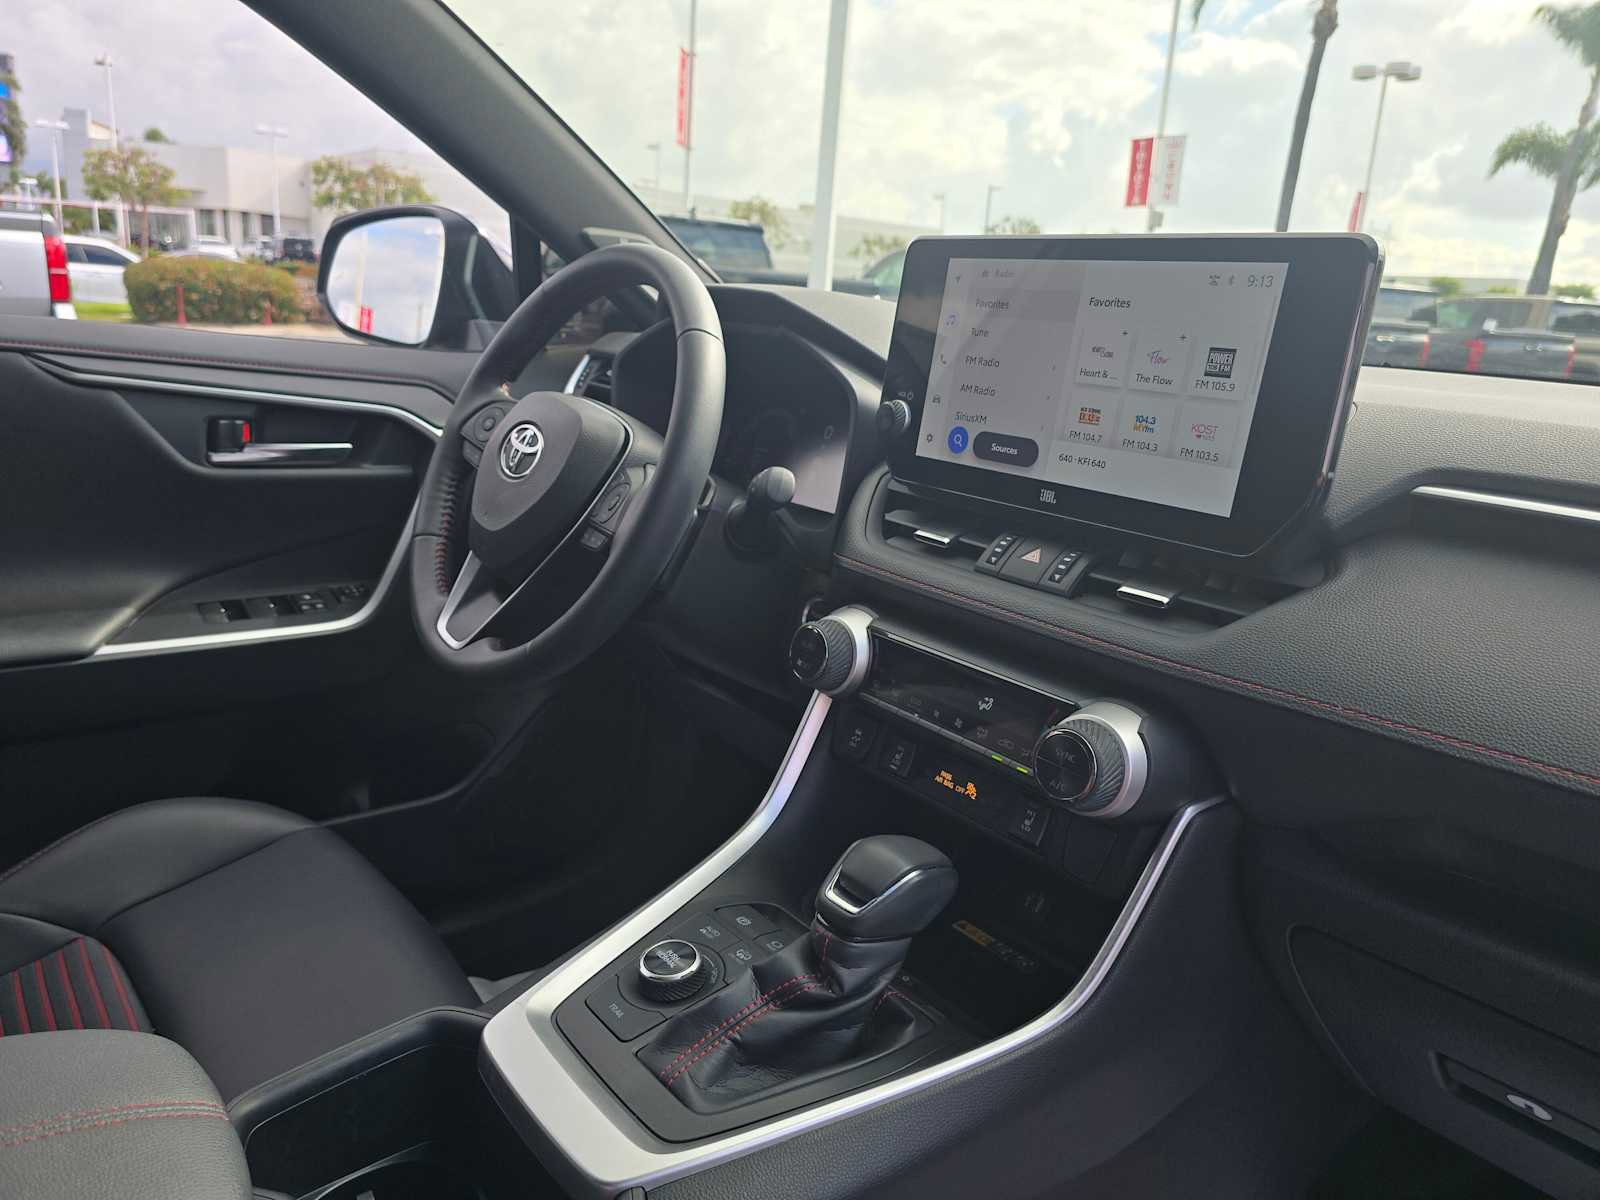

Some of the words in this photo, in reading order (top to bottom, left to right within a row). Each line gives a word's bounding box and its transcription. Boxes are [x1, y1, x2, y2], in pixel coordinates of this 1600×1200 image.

[1247, 274, 1274, 288] 9:13
[974, 298, 1010, 310] Favorites
[1088, 296, 1132, 309] Favorites
[970, 327, 990, 338] Tune
[964, 355, 977, 366] FM
[978, 356, 1000, 368] Radio
[1208, 351, 1234, 365] POWER
[1079, 367, 1101, 378] Heart
[1135, 373, 1151, 383] The
[1152, 375, 1174, 385] Flow
[960, 383, 973, 394] AM
[974, 385, 997, 397] Radio
[1195, 379, 1209, 390] FM
[1210, 381, 1236, 392] 105.9
[954, 411, 988, 424] SiriusXM
[1135, 415, 1157, 425] 104.3
[1190, 423, 1219, 435] KOST
[1069, 430, 1081, 441] FM
[1082, 431, 1103, 443] 104.7
[991, 443, 1018, 456] Sources
[1122, 438, 1135, 449] FM
[1136, 440, 1159, 453] 104.3
[1058, 453, 1073, 464] 640
[1078, 456, 1091, 467] KFI
[1091, 458, 1107, 469] 640
[1180, 447, 1194, 458] FM
[1195, 449, 1220, 463] 103.5
[1039, 488, 1057, 505] JBL
